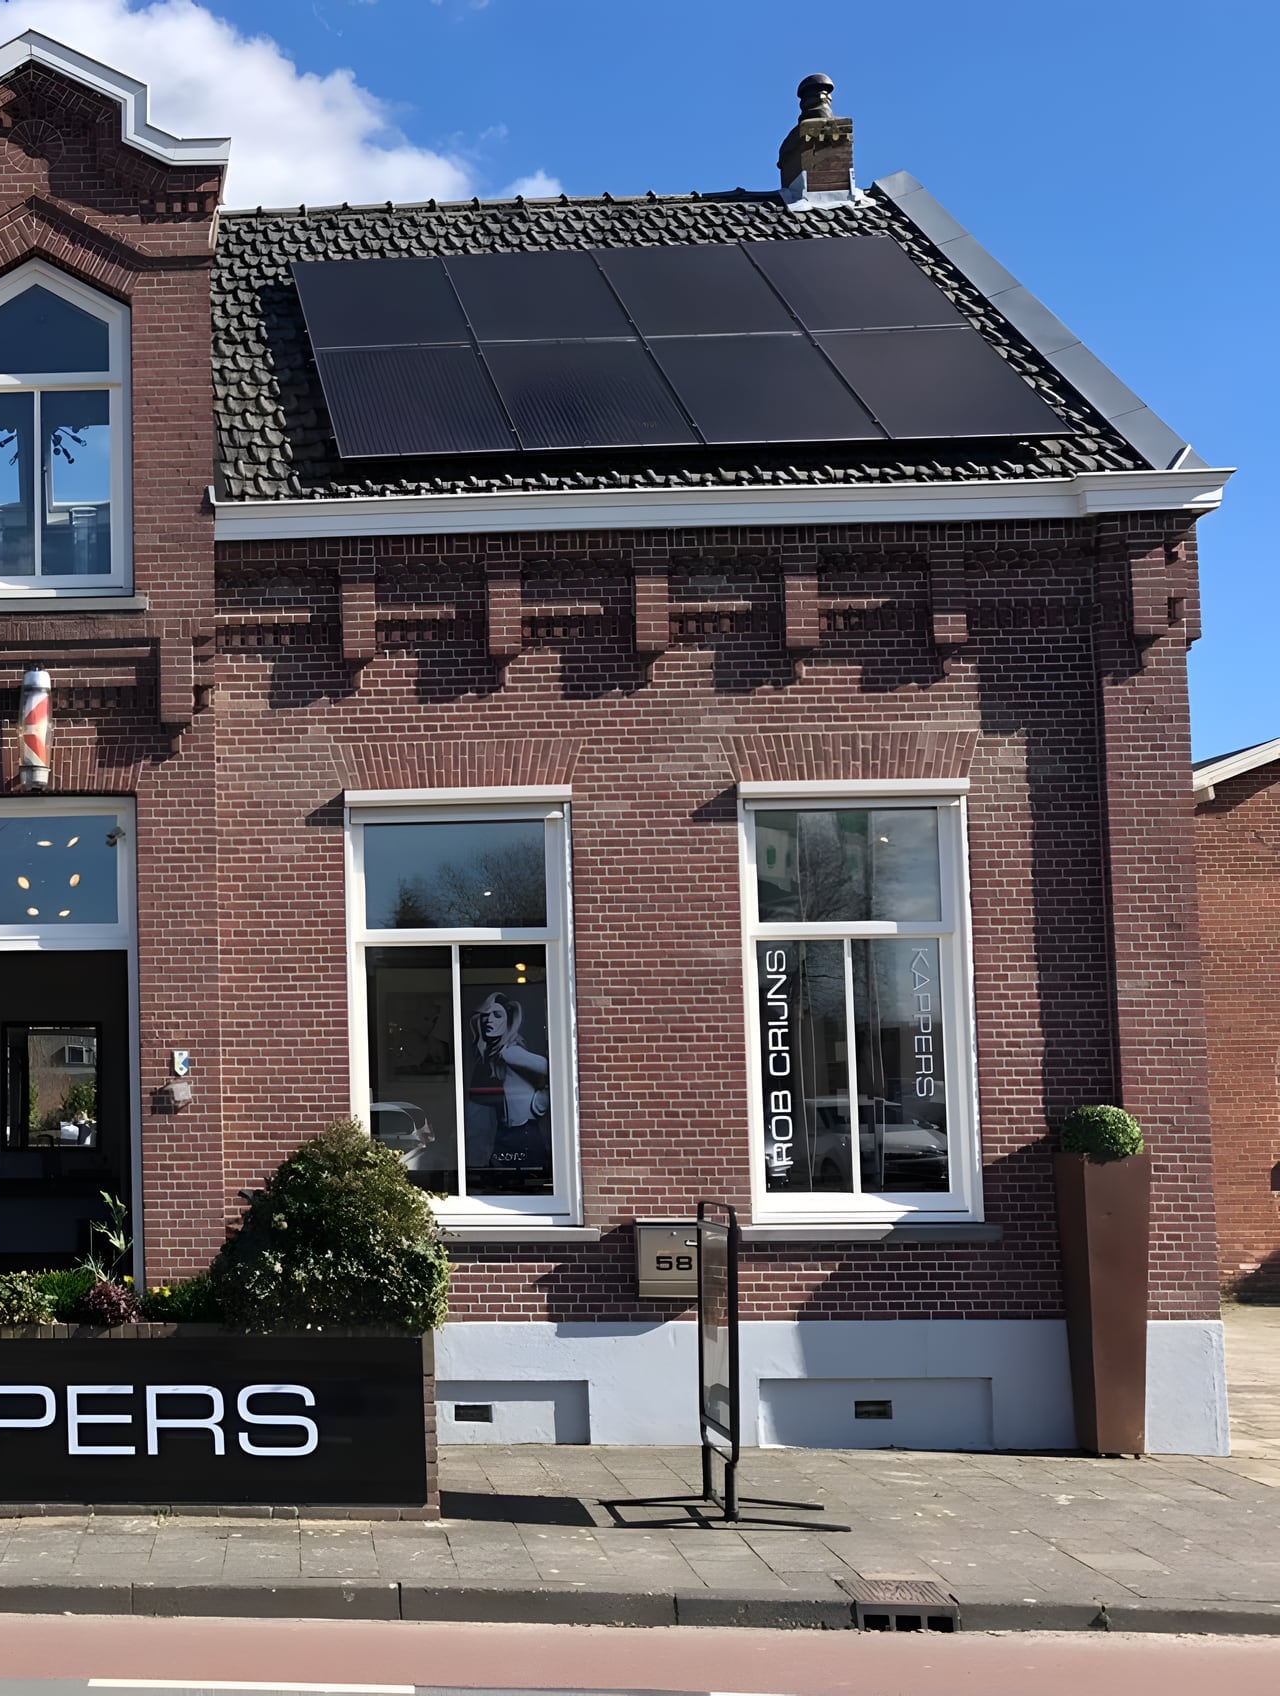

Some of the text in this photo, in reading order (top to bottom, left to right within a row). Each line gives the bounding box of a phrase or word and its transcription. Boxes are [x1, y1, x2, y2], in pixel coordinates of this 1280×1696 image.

[765, 949, 794, 1166] ROB CRIJNS
[911, 947, 935, 1098] KAPPERS
[655, 1255, 693, 1271] 58
